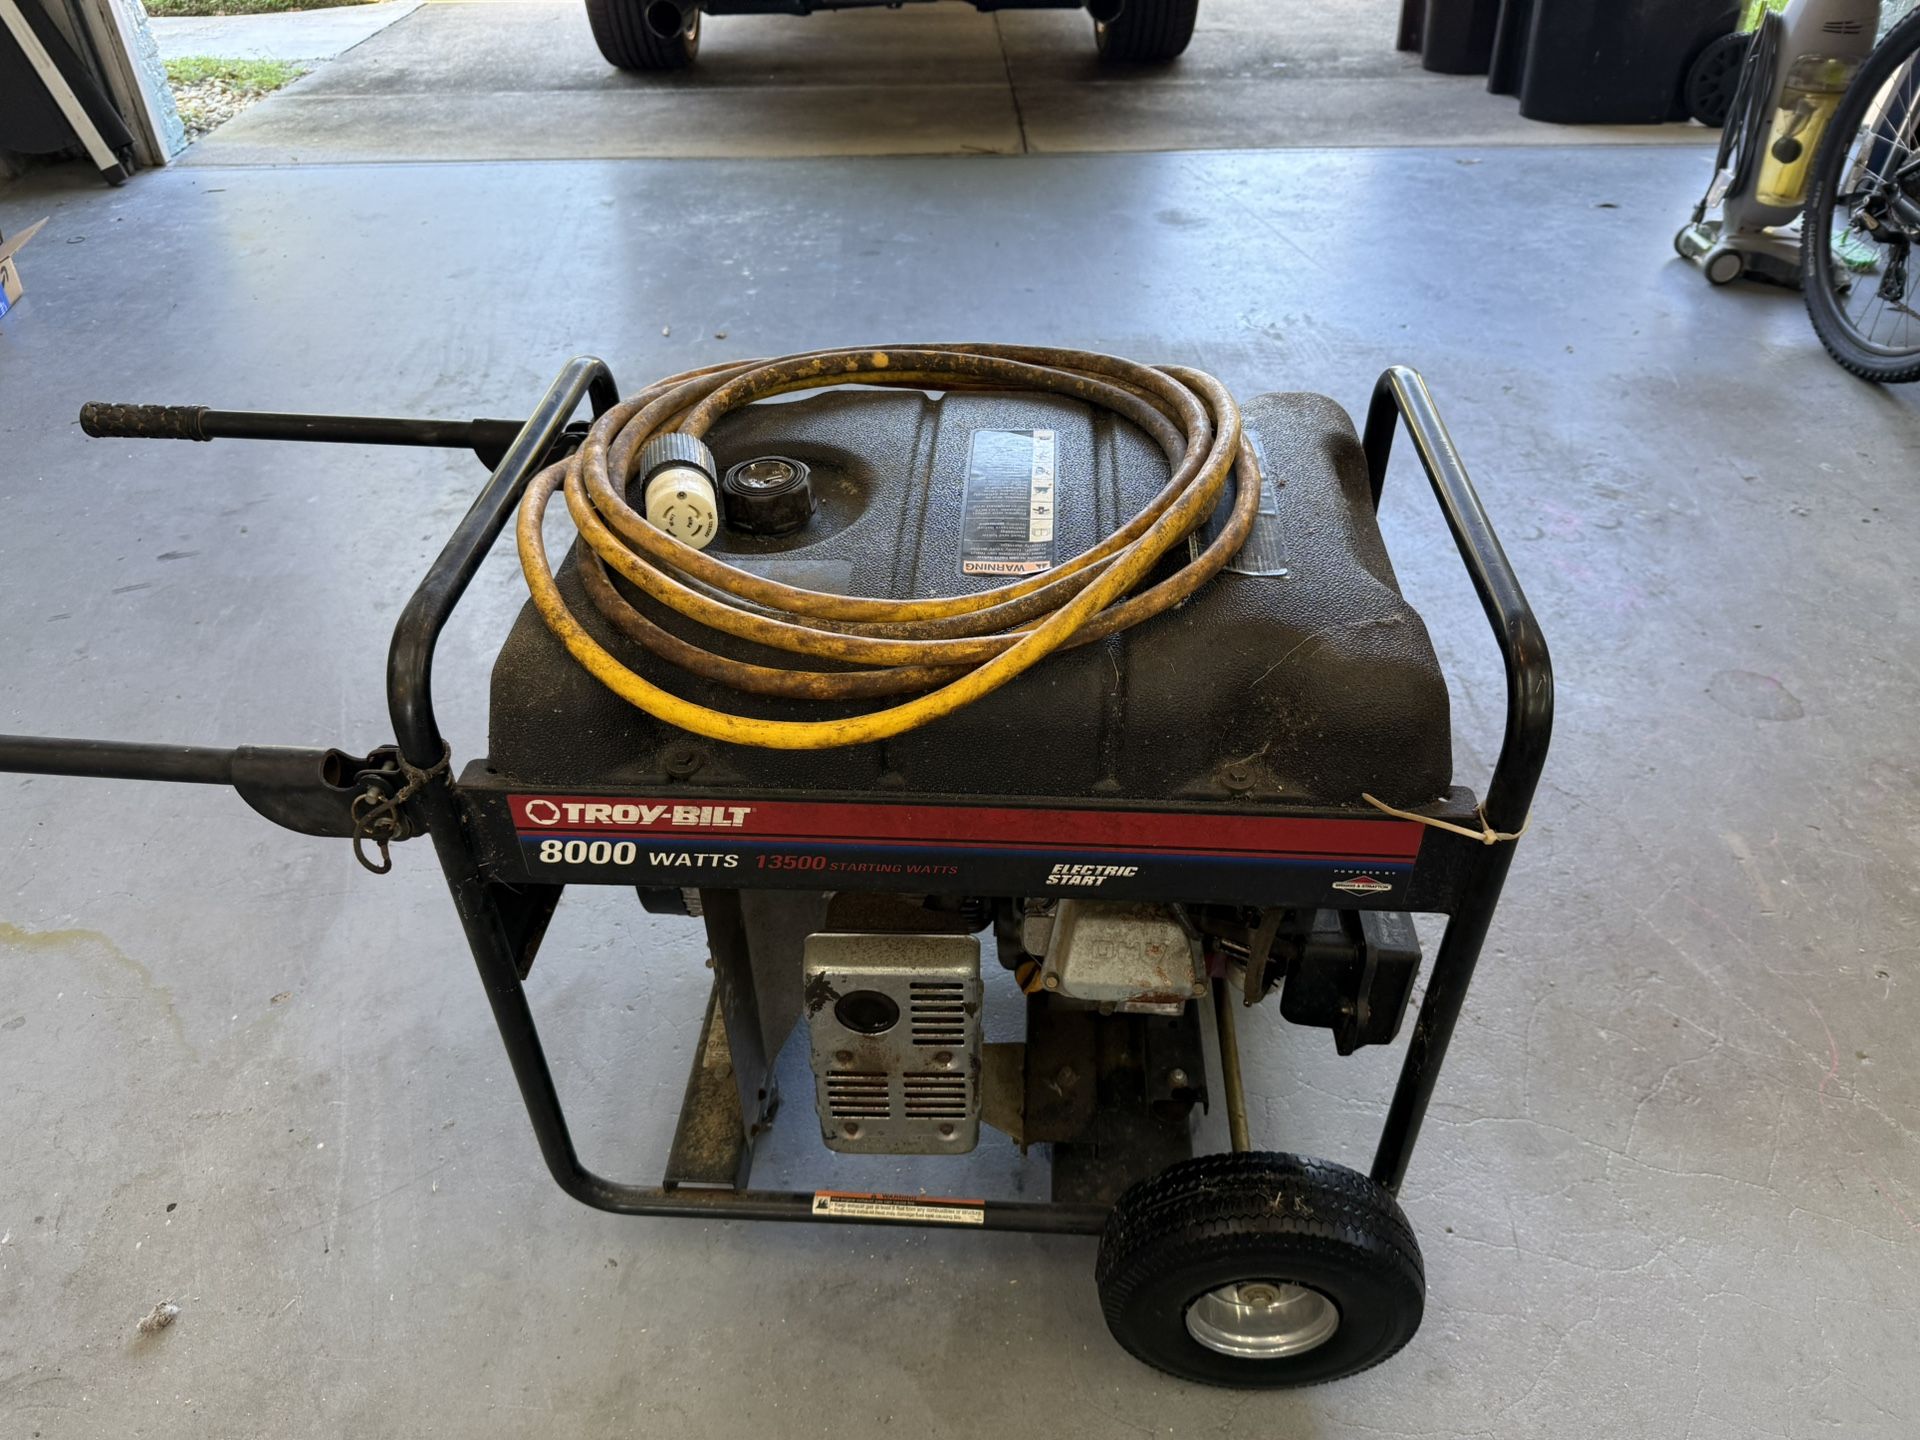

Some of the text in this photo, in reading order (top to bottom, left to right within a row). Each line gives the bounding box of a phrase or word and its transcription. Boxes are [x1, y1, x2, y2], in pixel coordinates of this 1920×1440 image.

[965, 562, 1025, 572] WARNING
[562, 803, 751, 827] TROY-BILT
[539, 840, 959, 875] 8000 WATTS 13500 STARTING WATTS
[1051, 864, 1138, 877] ELECTRIC
[1045, 874, 1107, 887] START
